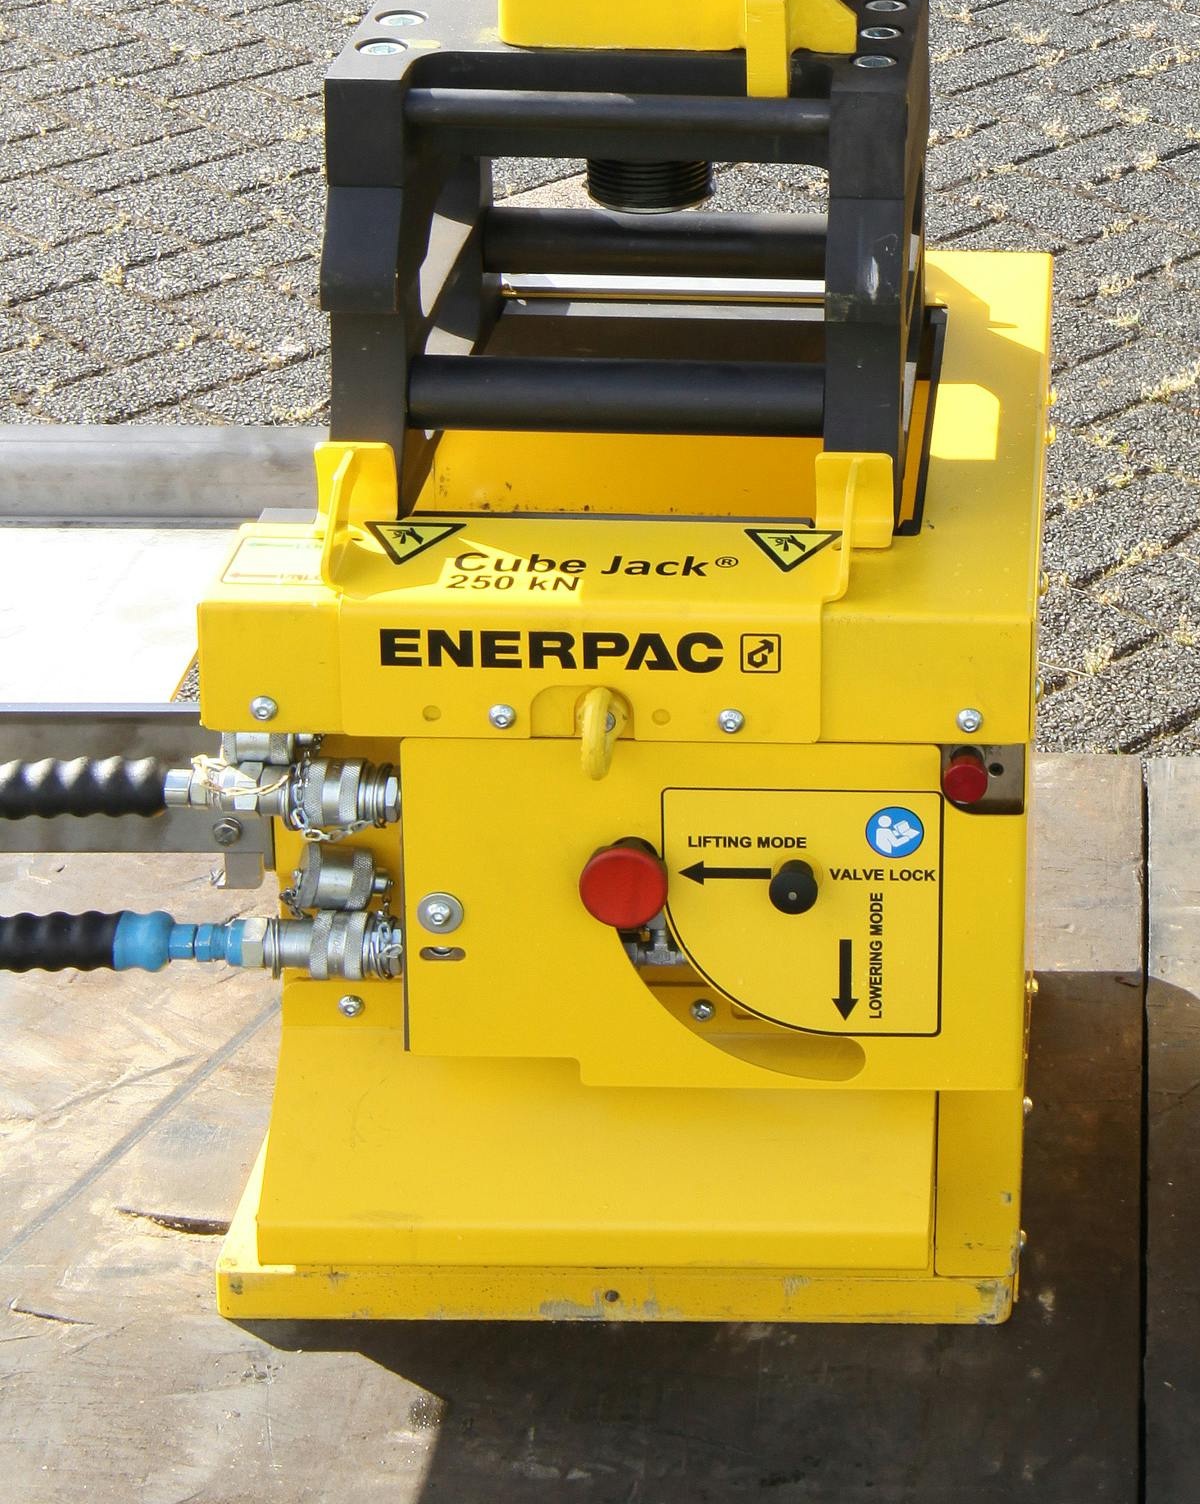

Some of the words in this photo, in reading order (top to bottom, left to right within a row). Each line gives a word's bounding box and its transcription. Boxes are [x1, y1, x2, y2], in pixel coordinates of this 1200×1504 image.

[454, 552, 587, 575] Cube
[446, 574, 515, 591] 250
[527, 574, 580, 592] kN
[379, 628, 724, 674] ENERPAC
[687, 835, 752, 848] LIFTING
[756, 837, 807, 848] MODE
[829, 868, 885, 881] VALVE
[889, 869, 936, 881] LOCK
[869, 892, 883, 936] MODE
[869, 940, 883, 1019] LOWERING
